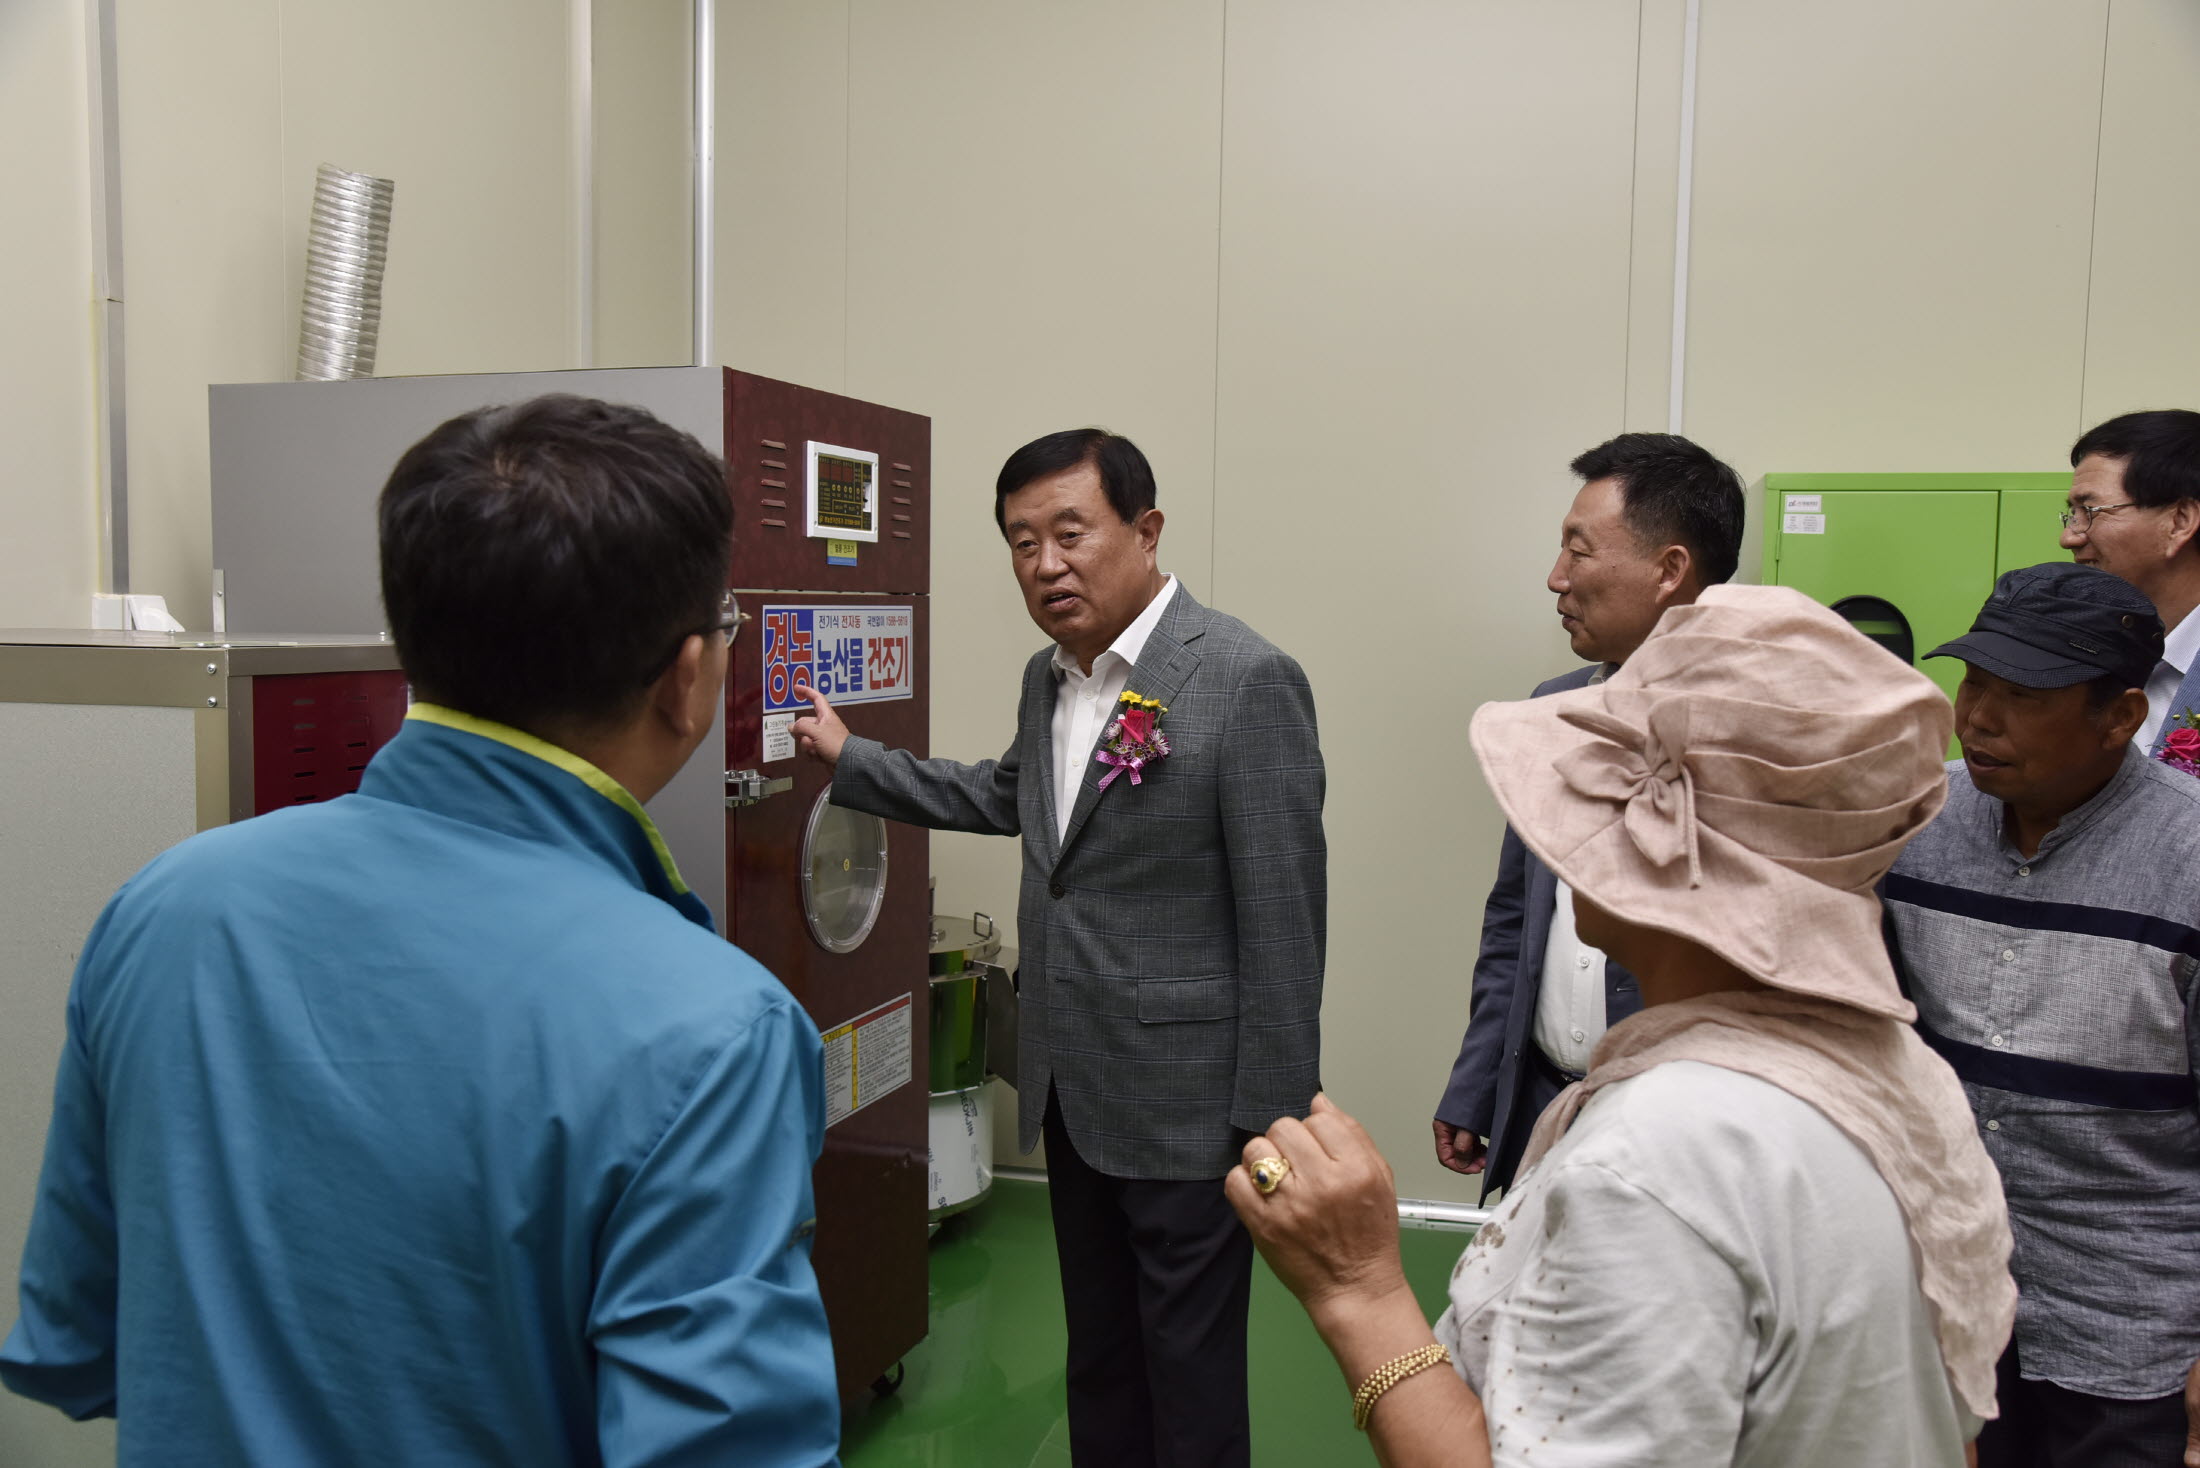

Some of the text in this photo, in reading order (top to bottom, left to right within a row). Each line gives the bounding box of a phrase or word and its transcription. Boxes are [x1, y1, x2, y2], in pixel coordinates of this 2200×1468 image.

[819, 615, 839, 629] 전기식
[841, 615, 861, 628] 전자동
[766, 612, 812, 705] 경농
[817, 635, 908, 695] 농산물 건조기
